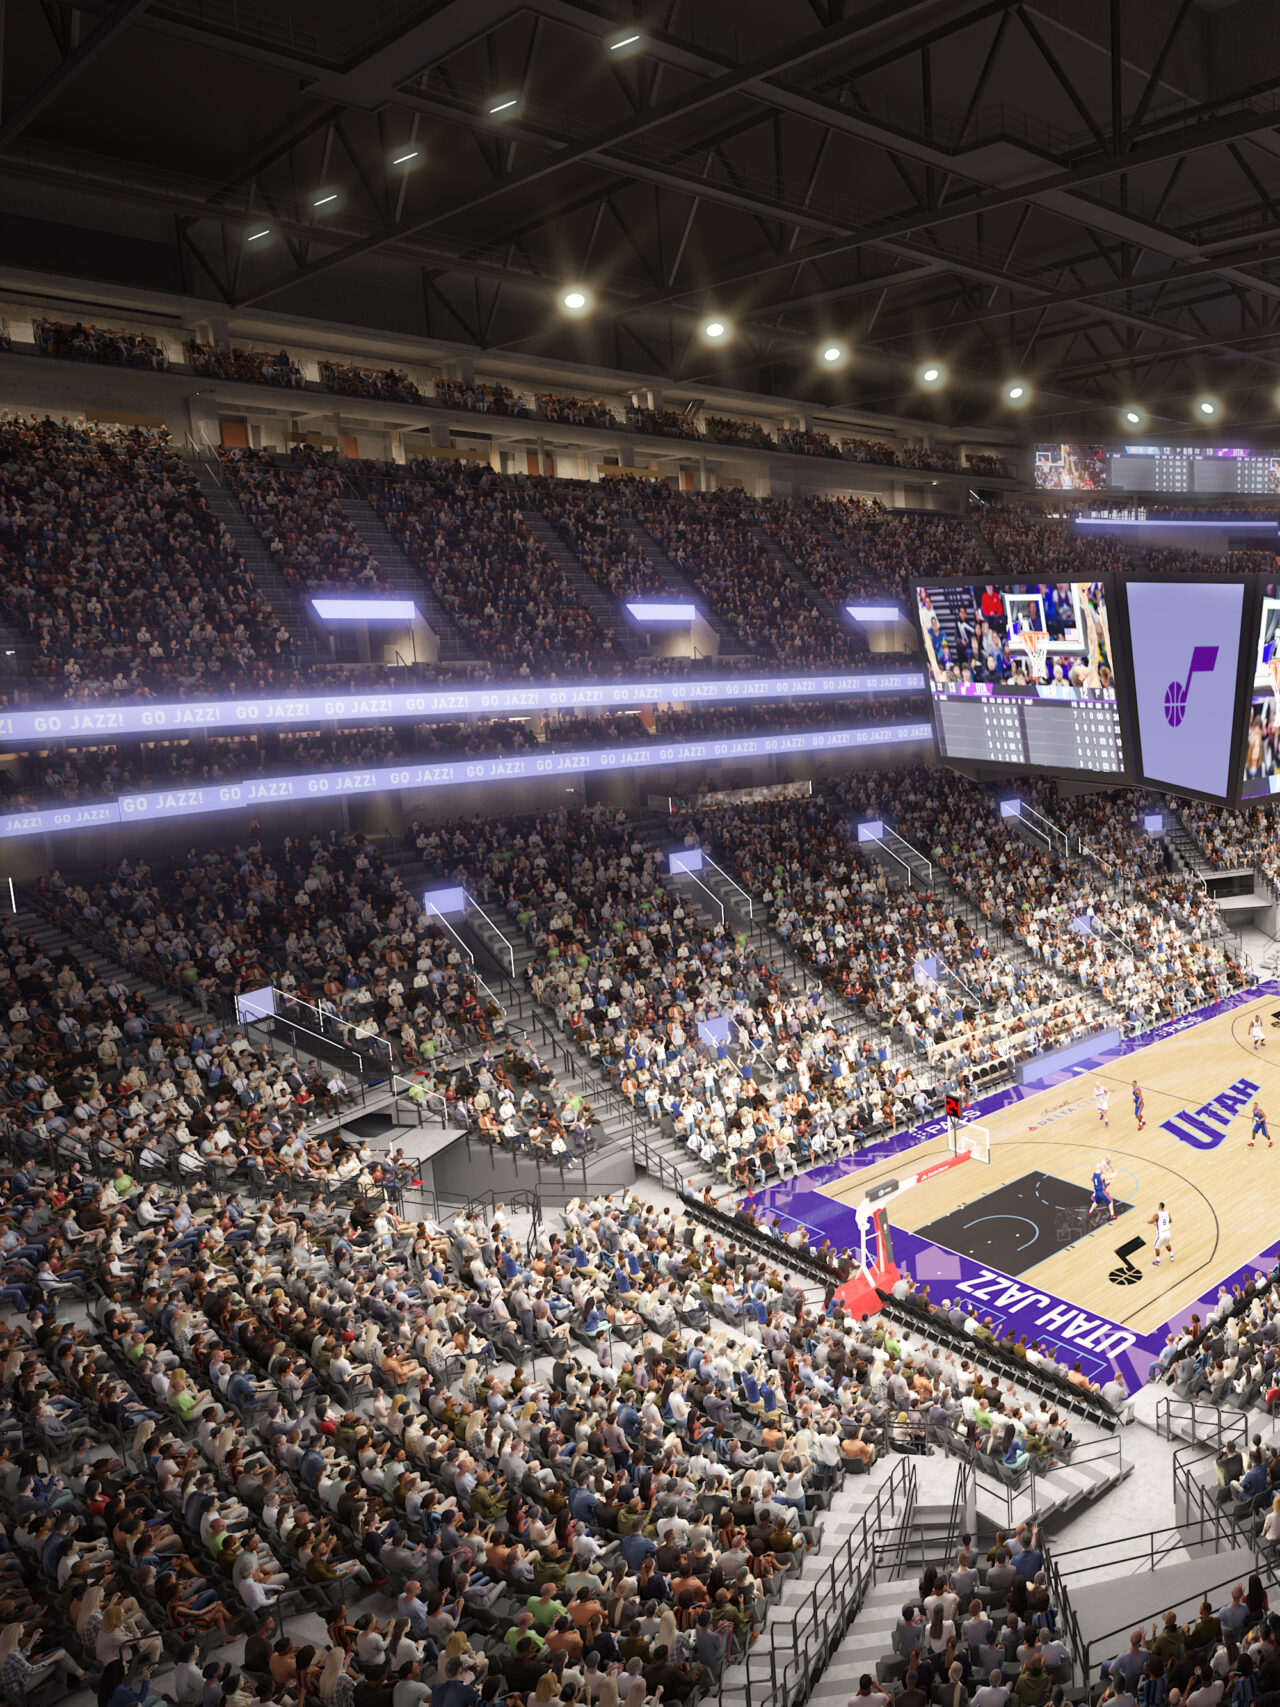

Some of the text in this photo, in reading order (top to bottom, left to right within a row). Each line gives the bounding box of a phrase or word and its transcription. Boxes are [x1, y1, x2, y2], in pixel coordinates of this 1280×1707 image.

[34, 716, 61, 732] GO
[70, 713, 125, 730] JAZZ!
[141, 711, 166, 725] GO
[173, 707, 221, 723] JAZZ!
[236, 705, 259, 719] GO
[265, 703, 310, 718] JAZZ!
[324, 702, 345, 714] GO
[351, 699, 393, 713] JAZZ!
[406, 698, 425, 710] GO
[431, 696, 469, 709] JAZZ!
[481, 695, 499, 707] GO
[504, 693, 539, 706] JAZZ!
[550, 692, 567, 703] GO
[571, 690, 604, 702] JAZZ!
[613, 689, 629, 700] GO
[632, 688, 663, 699] JAZZ!
[672, 687, 686, 697] GO
[690, 685, 718, 697] JAZZ!
[726, 684, 739, 694] GO
[743, 683, 768, 694] JAZZ!
[776, 682, 789, 692] GO
[791, 681, 816, 691] JAZZ!
[823, 680, 834, 690] GO
[837, 679, 860, 689] JAZZ!
[866, 678, 877, 688] GO
[879, 677, 901, 687] JAZZ!
[908, 677, 918, 686] GO
[948, 682, 956, 693] 13
[6, 726, 931, 831] JAZZ! GO JAZZ! GO JAZZ! GO JAZZ! GO JAZZ! GO JAZZ! GO JAZZ! GO JAZZ! GO JAZZ! GO JAZZ! GO JAZZ! GO JAZZ! GO JAZZ! GO JAZZ! GO JAZZ!
[924, 1110, 981, 1134] PAS
[946, 1097, 960, 1117] 24
[1157, 1076, 1262, 1150] UTAH
[955, 1269, 1137, 1359] UTAH JAZZ
